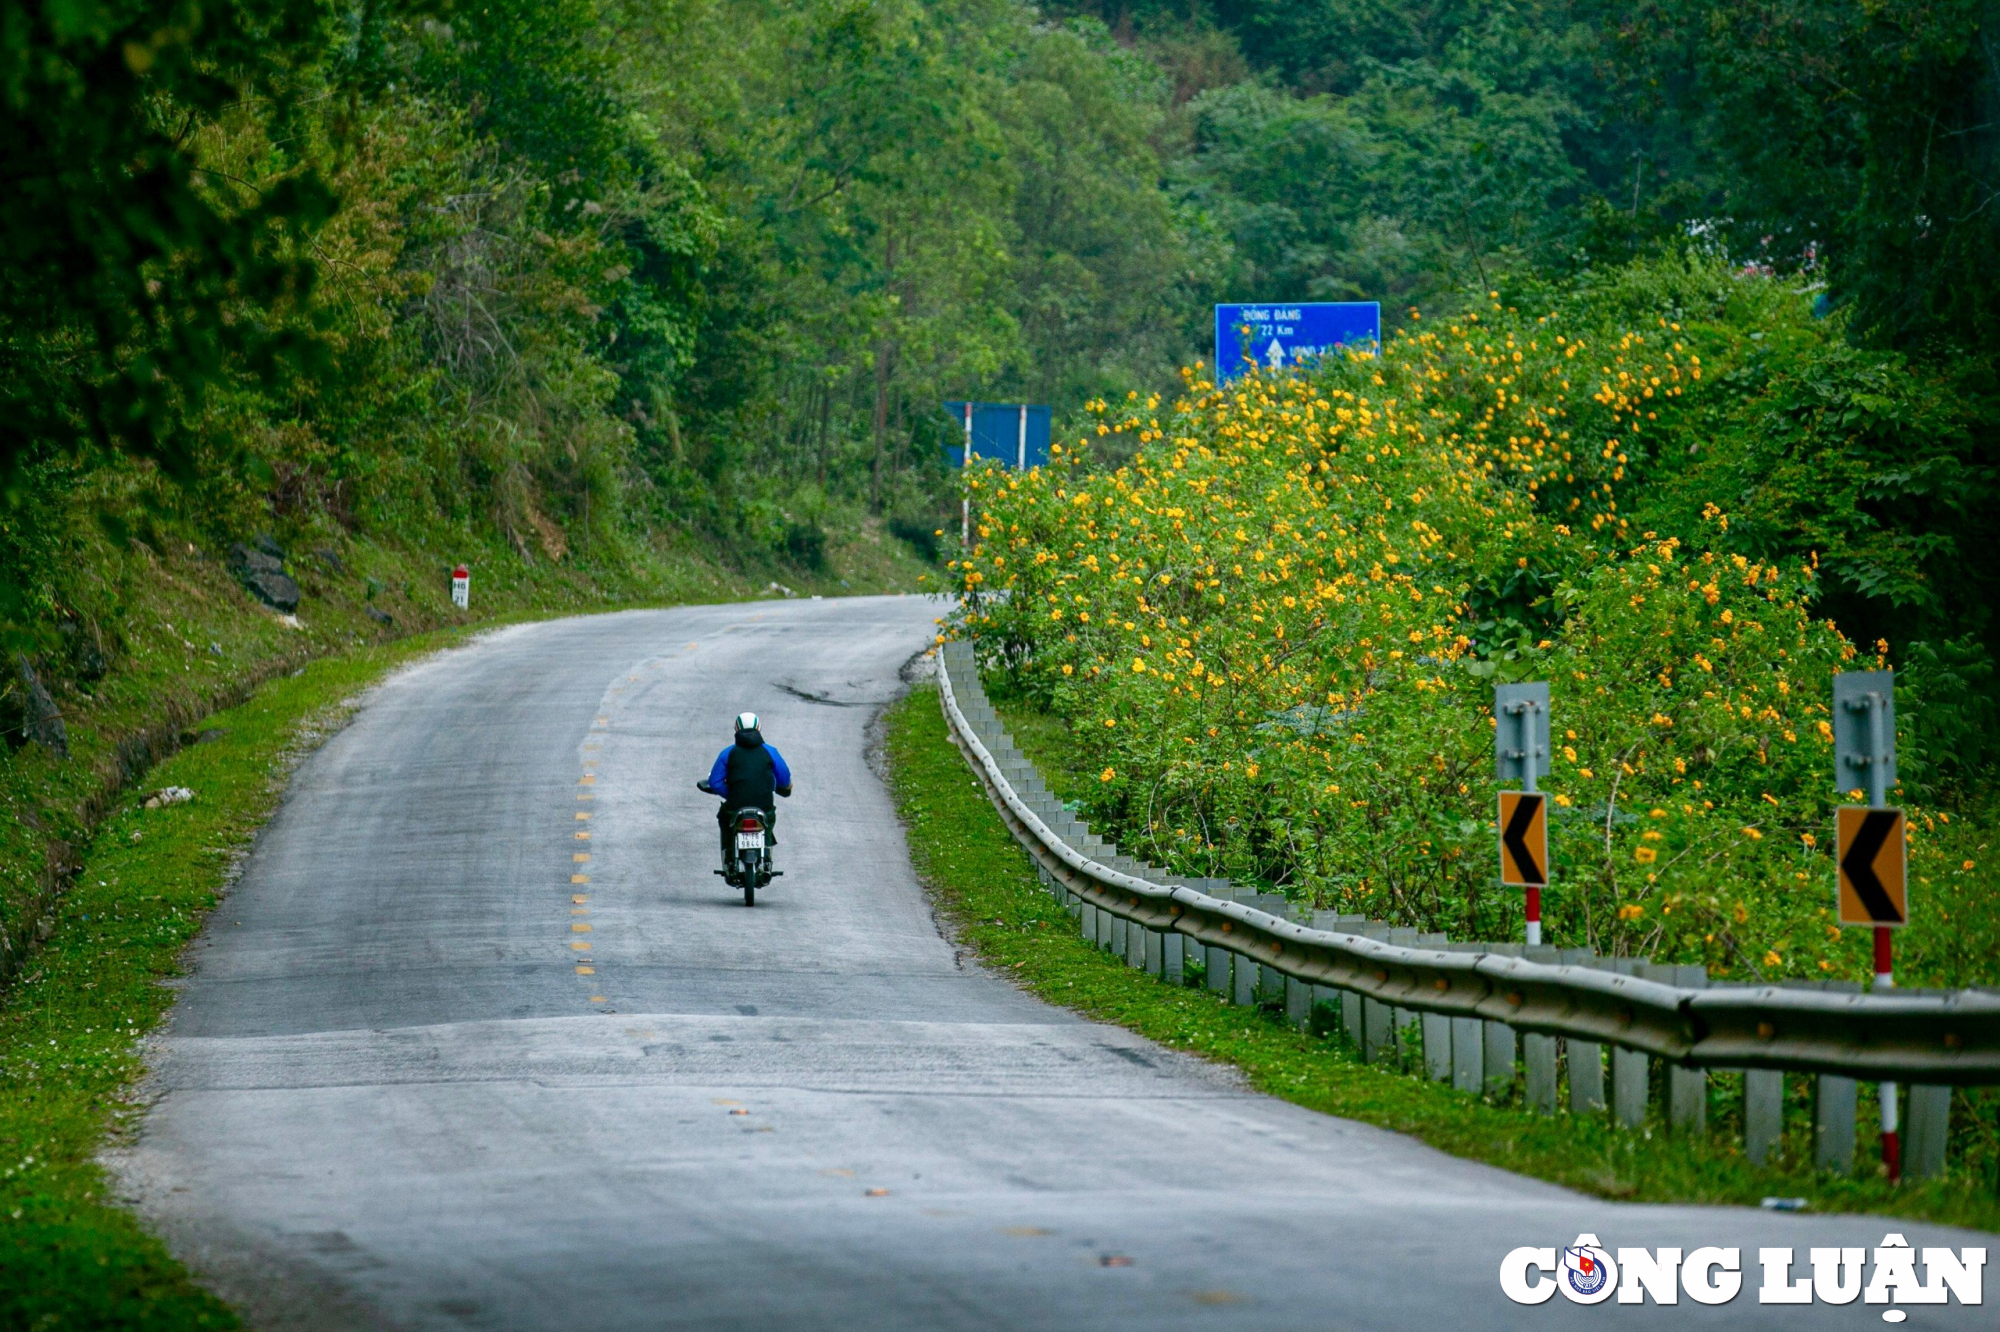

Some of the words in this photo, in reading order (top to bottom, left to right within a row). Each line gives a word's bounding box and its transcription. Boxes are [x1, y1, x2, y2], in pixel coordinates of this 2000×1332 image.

[1261, 324, 1273, 336] 22
[1277, 324, 1294, 335] Km
[741, 840, 759, 848] 9844
